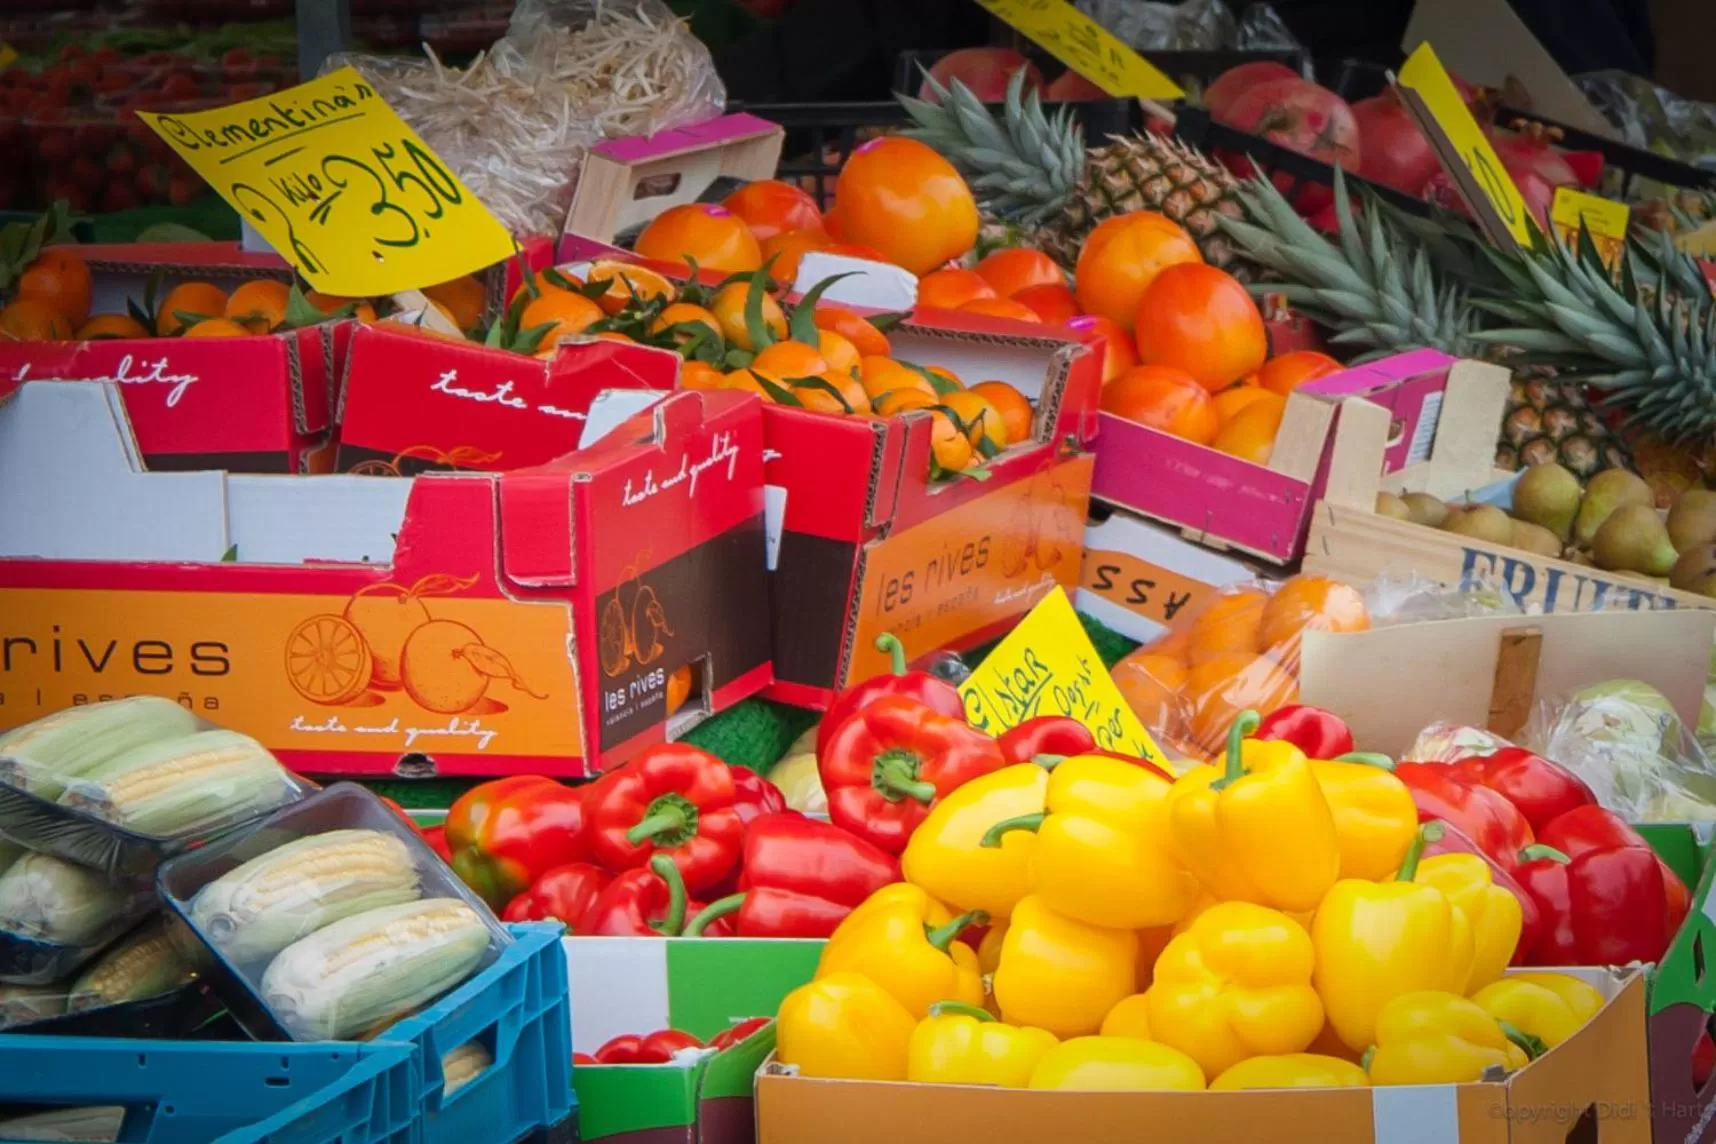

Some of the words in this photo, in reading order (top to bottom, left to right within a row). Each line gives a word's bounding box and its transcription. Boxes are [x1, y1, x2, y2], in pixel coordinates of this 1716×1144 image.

[430, 369, 528, 409] taste
[537, 405, 588, 420] an
[622, 469, 658, 506] taste
[660, 453, 688, 489] and
[689, 430, 739, 499] quality
[876, 569, 915, 617] les
[924, 535, 991, 593] rives
[3, 624, 231, 676] rives
[604, 688, 626, 712] les
[630, 667, 664, 699] rives
[290, 715, 347, 732] taste
[354, 718, 399, 733] and
[405, 717, 498, 749] quality
